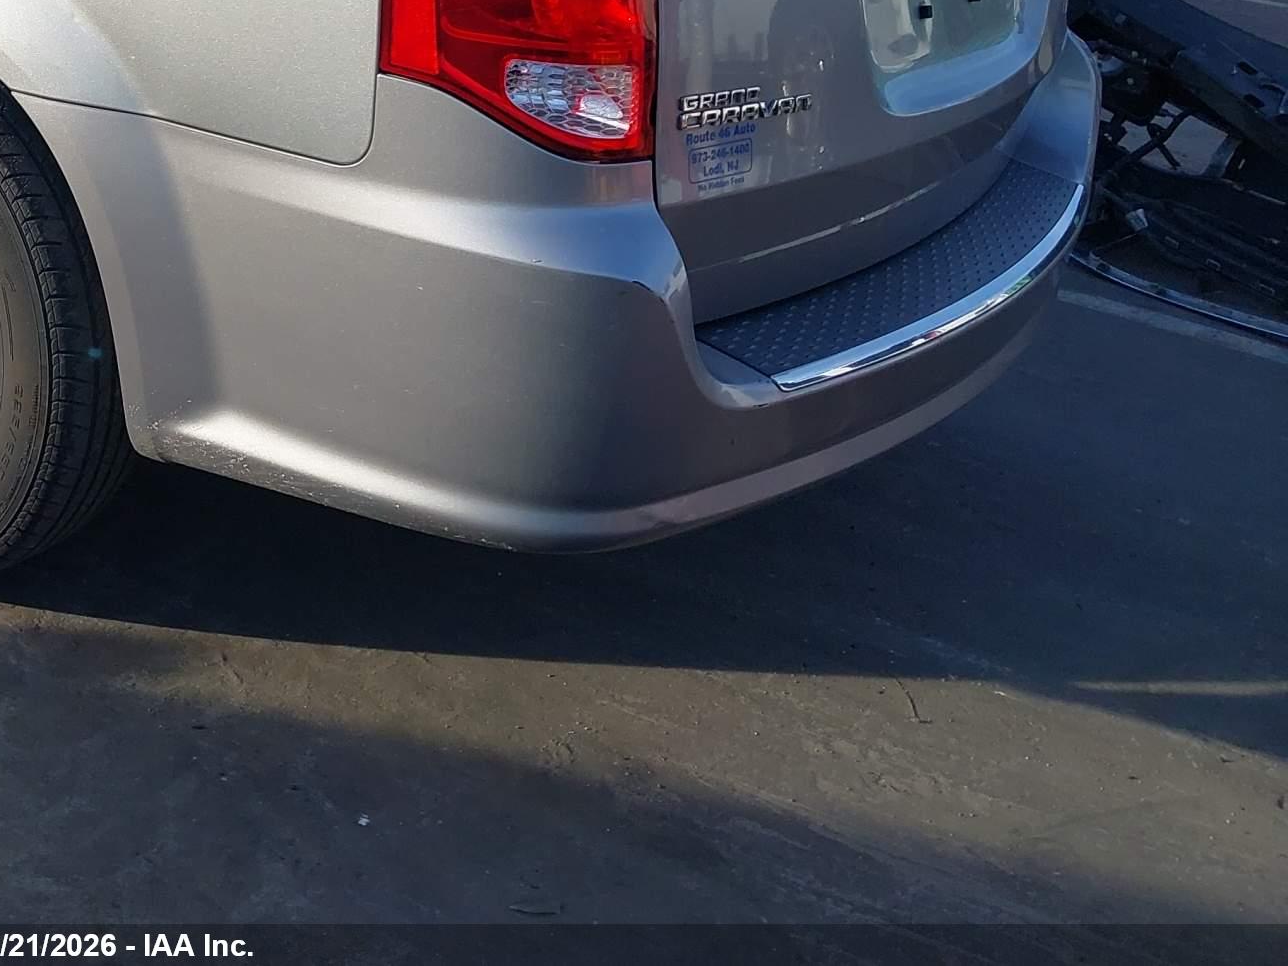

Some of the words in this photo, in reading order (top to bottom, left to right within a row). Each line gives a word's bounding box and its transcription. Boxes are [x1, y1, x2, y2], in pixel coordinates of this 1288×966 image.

[677, 93, 813, 130] CARAVAN
[679, 86, 761, 112] GRAND
[685, 130, 715, 146] Route
[733, 121, 756, 136] Auto
[727, 159, 739, 173] NJ
